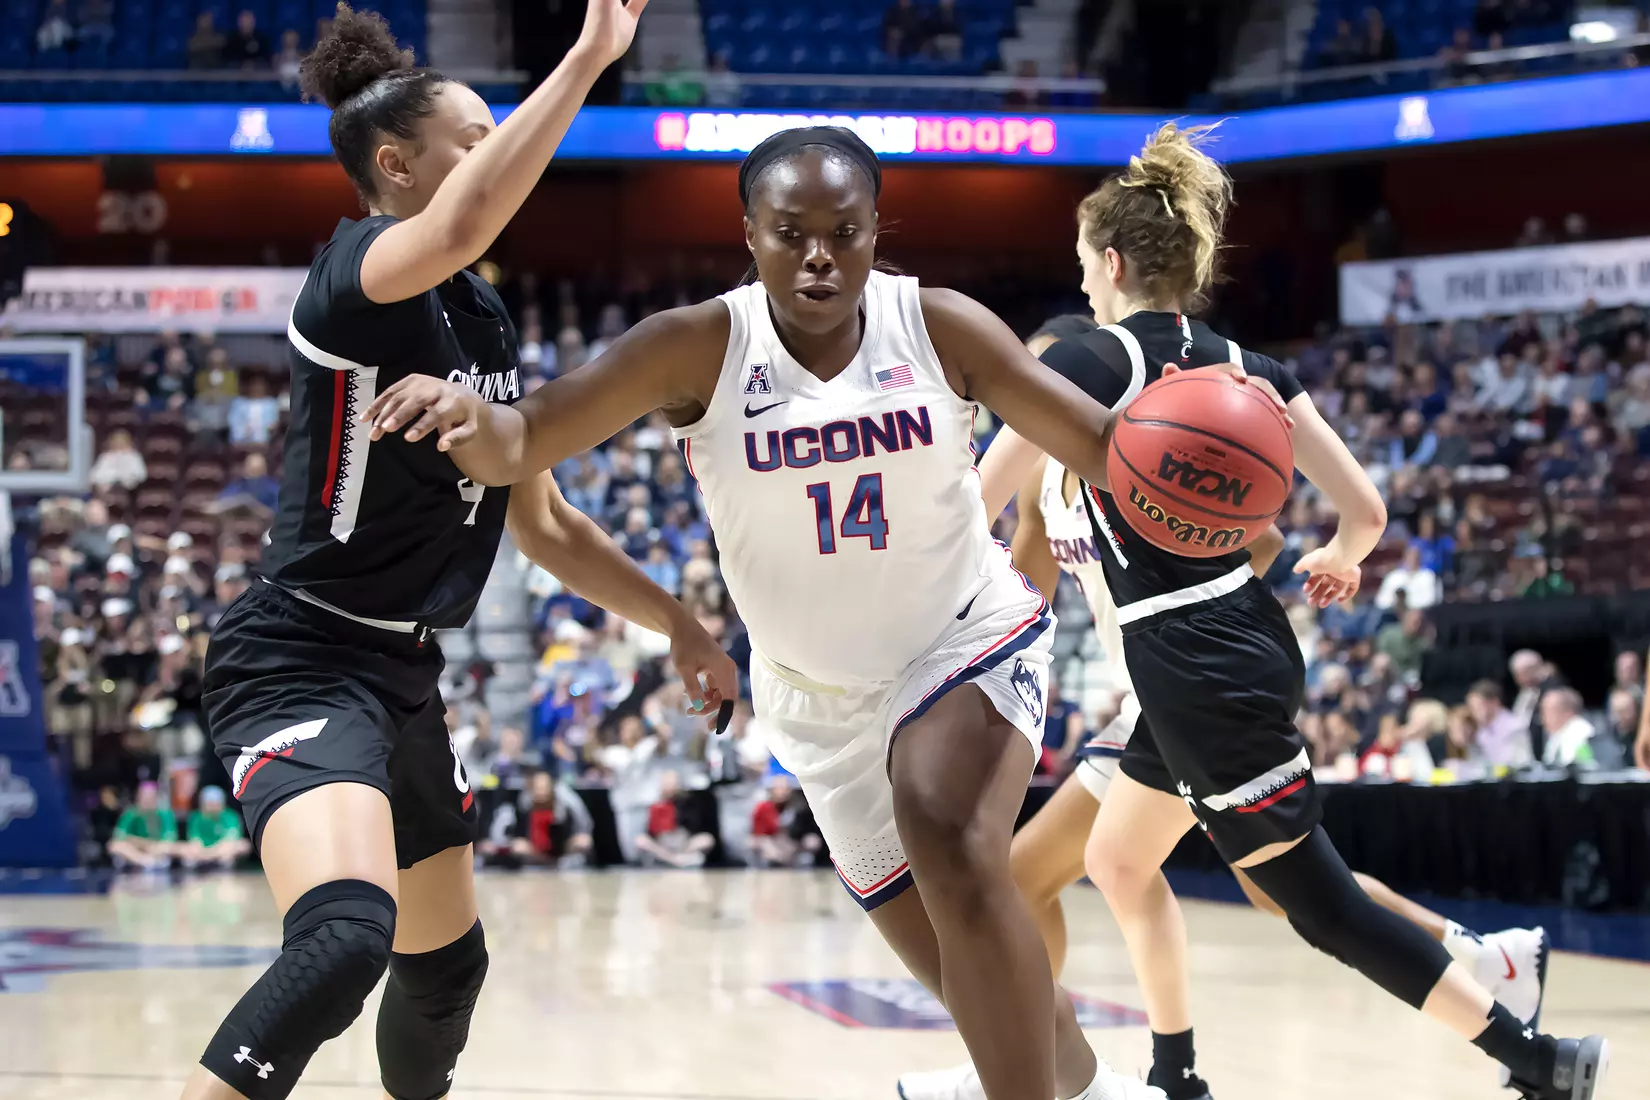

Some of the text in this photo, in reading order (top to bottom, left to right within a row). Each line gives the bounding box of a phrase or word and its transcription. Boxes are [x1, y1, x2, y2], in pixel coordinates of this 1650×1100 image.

[98, 190, 168, 234] 20
[744, 405, 934, 472] UCONN
[1157, 451, 1253, 507] NCAA
[806, 472, 889, 555] 14
[1128, 481, 1247, 548] Wilson
